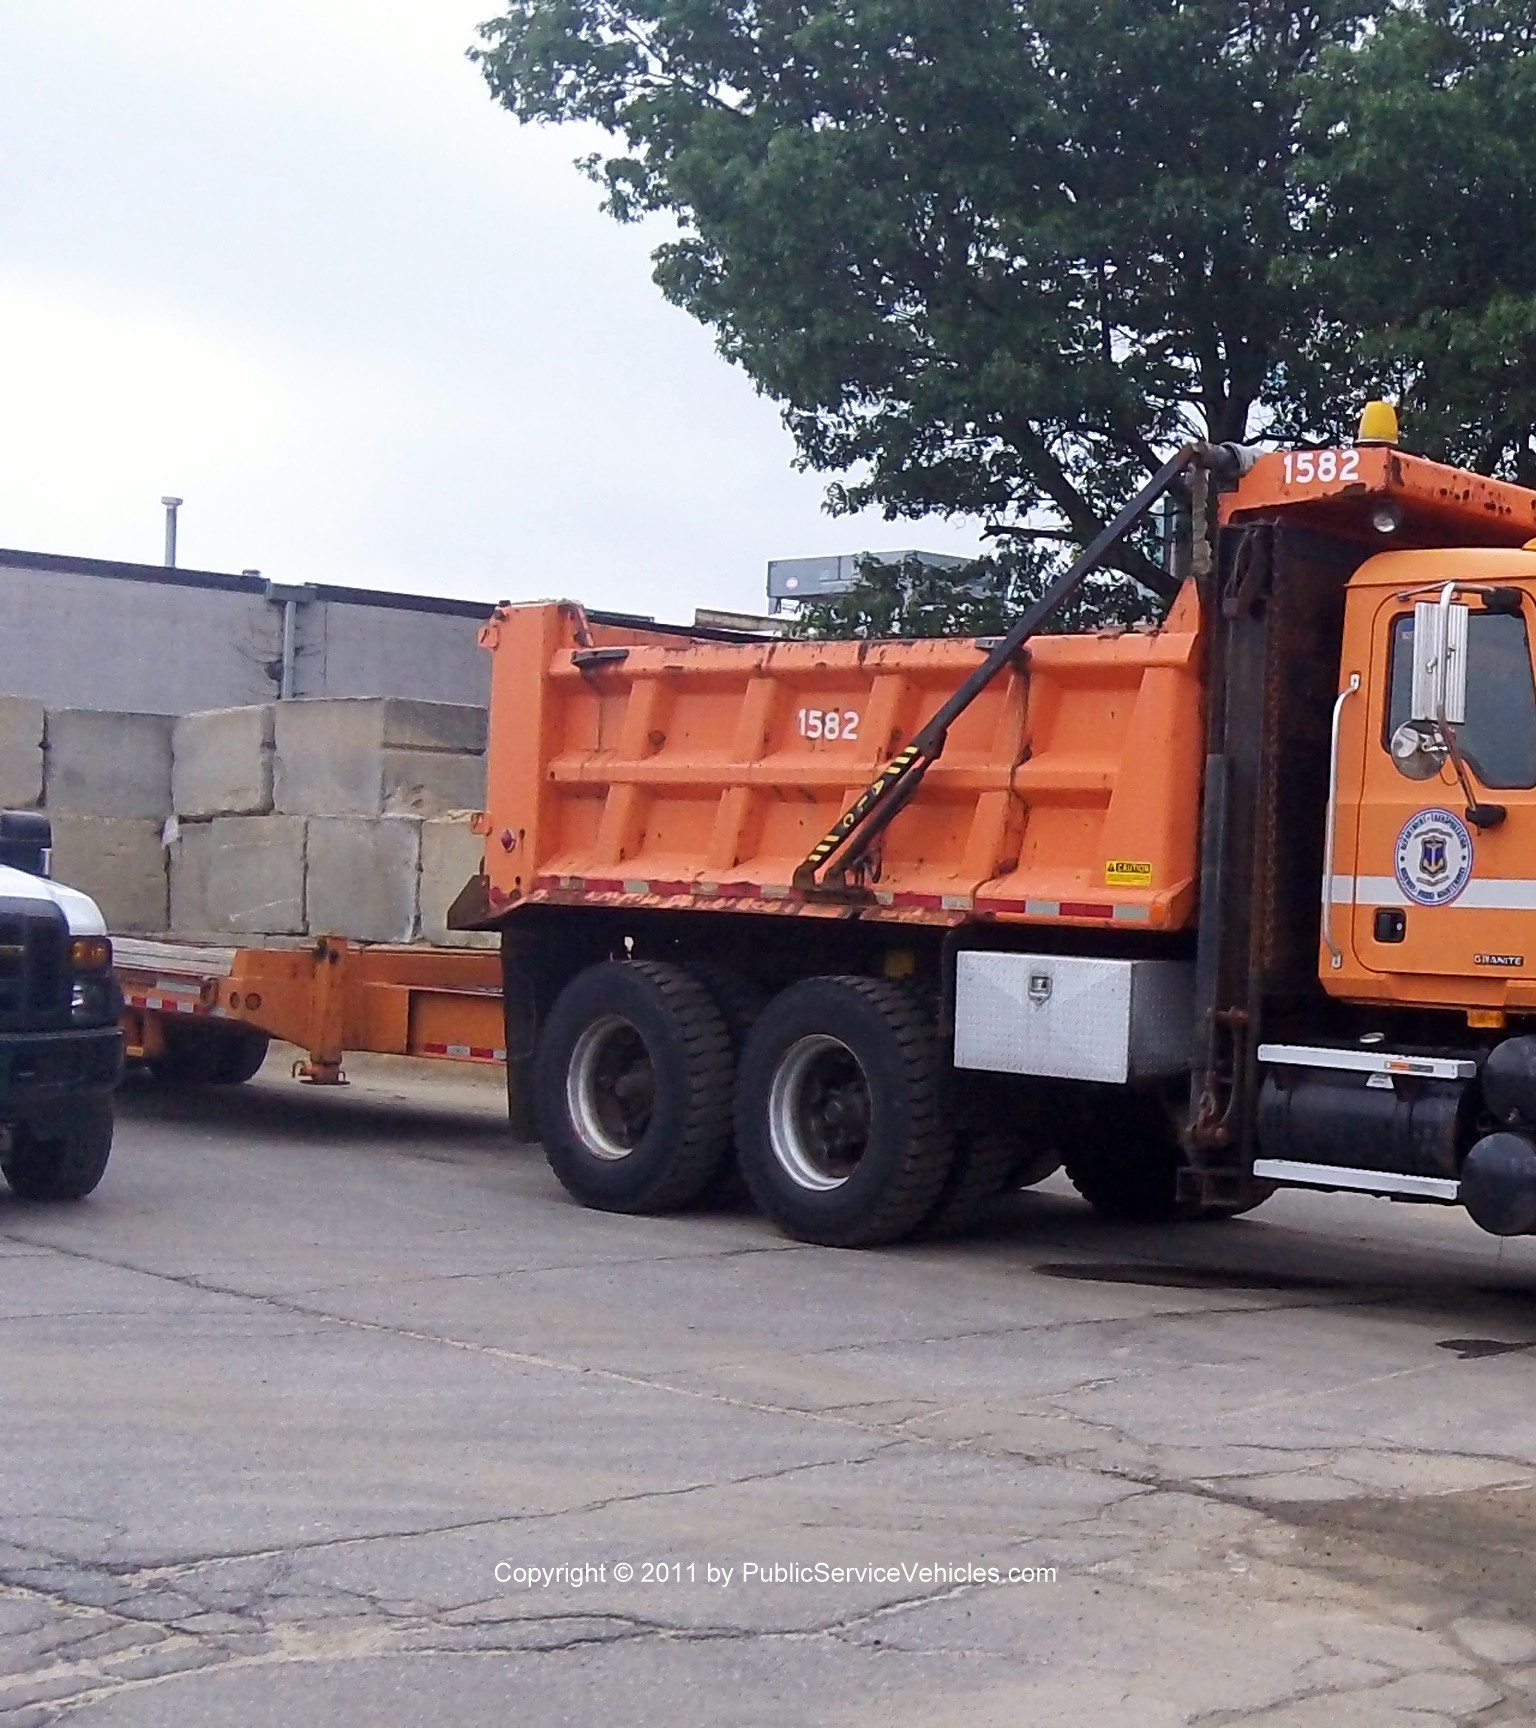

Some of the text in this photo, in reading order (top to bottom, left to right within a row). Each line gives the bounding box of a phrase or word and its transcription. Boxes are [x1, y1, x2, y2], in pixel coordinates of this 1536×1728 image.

[1283, 449, 1360, 485] 1582
[799, 708, 859, 740] 1582
[1474, 955, 1522, 966] GRANITE
